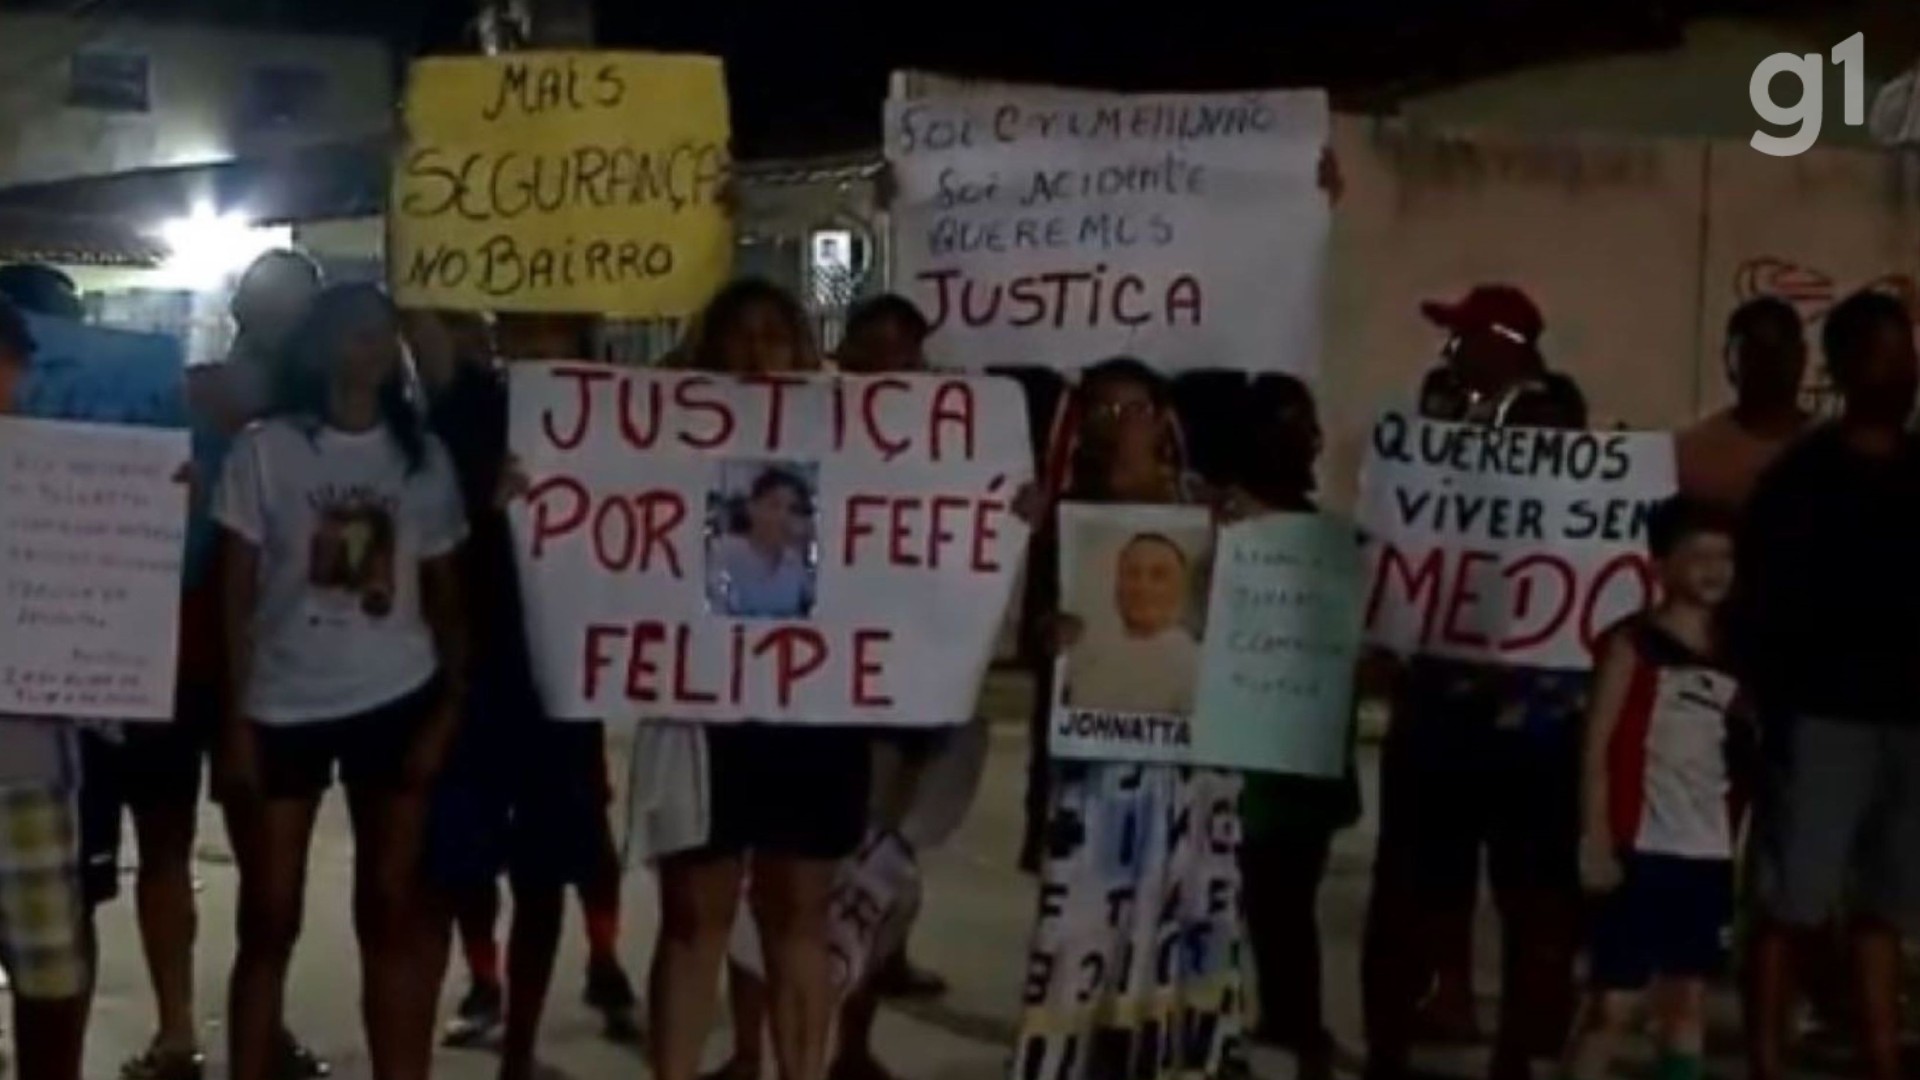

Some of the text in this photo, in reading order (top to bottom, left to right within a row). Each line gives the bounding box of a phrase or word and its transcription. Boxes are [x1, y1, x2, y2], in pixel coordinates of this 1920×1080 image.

[402, 247, 468, 289] NO
[1374, 412, 1630, 481] QUEREMOS
[526, 473, 1004, 578] POR FEFÉ
[1365, 543, 1654, 651] MEDO
[1059, 711, 1191, 745] JOHNATTA
